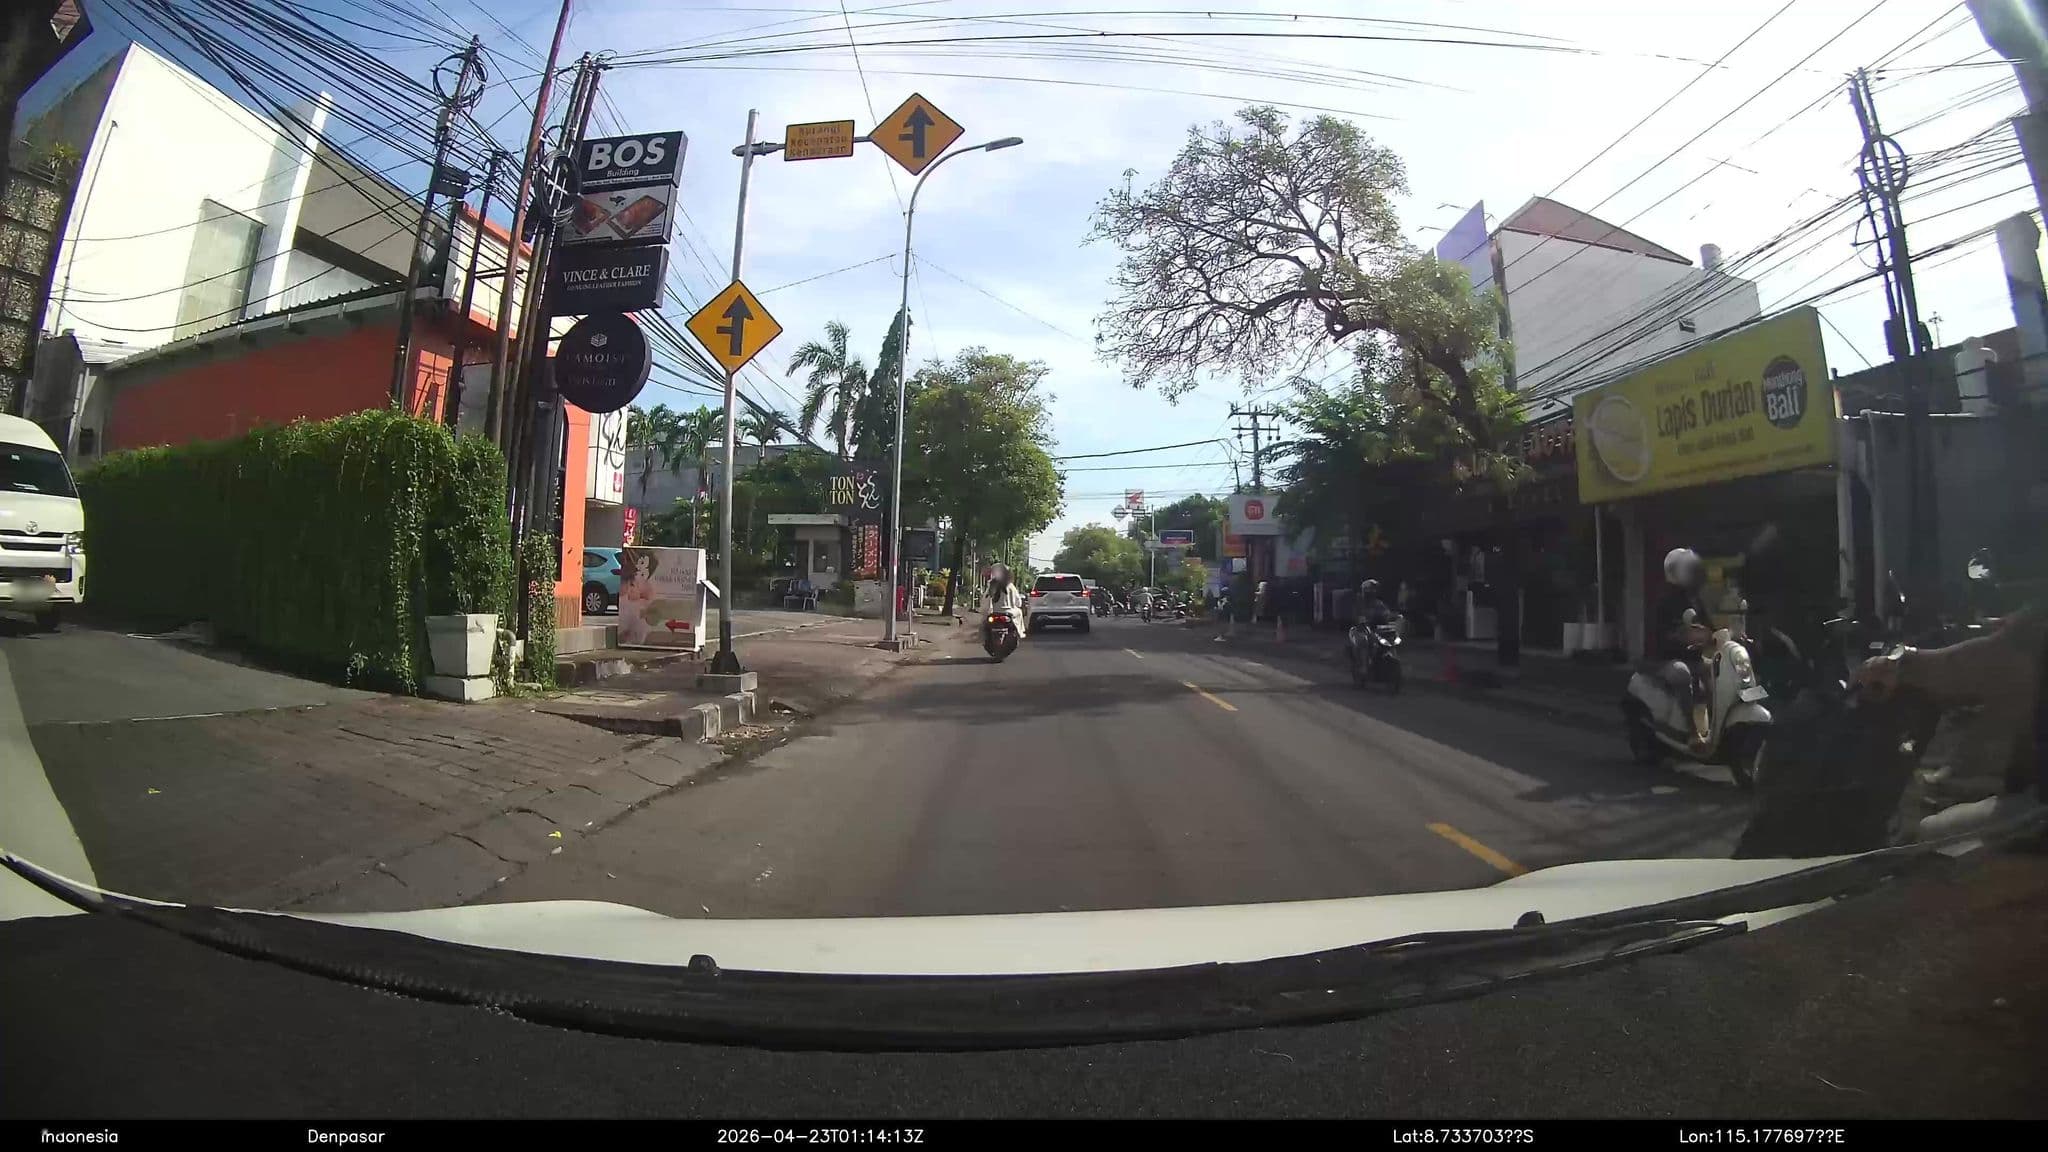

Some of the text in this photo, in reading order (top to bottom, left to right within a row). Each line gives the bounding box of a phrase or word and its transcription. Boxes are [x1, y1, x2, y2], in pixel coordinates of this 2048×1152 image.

[588, 137, 667, 171] BOS
[606, 167, 640, 178] Building
[563, 264, 651, 283] VINCE & CLARE
[1656, 395, 1698, 440] Lapis
[1700, 380, 1756, 426] Durian
[1766, 385, 1801, 421] Bali
[829, 476, 855, 491] TON
[829, 490, 855, 505] TON
